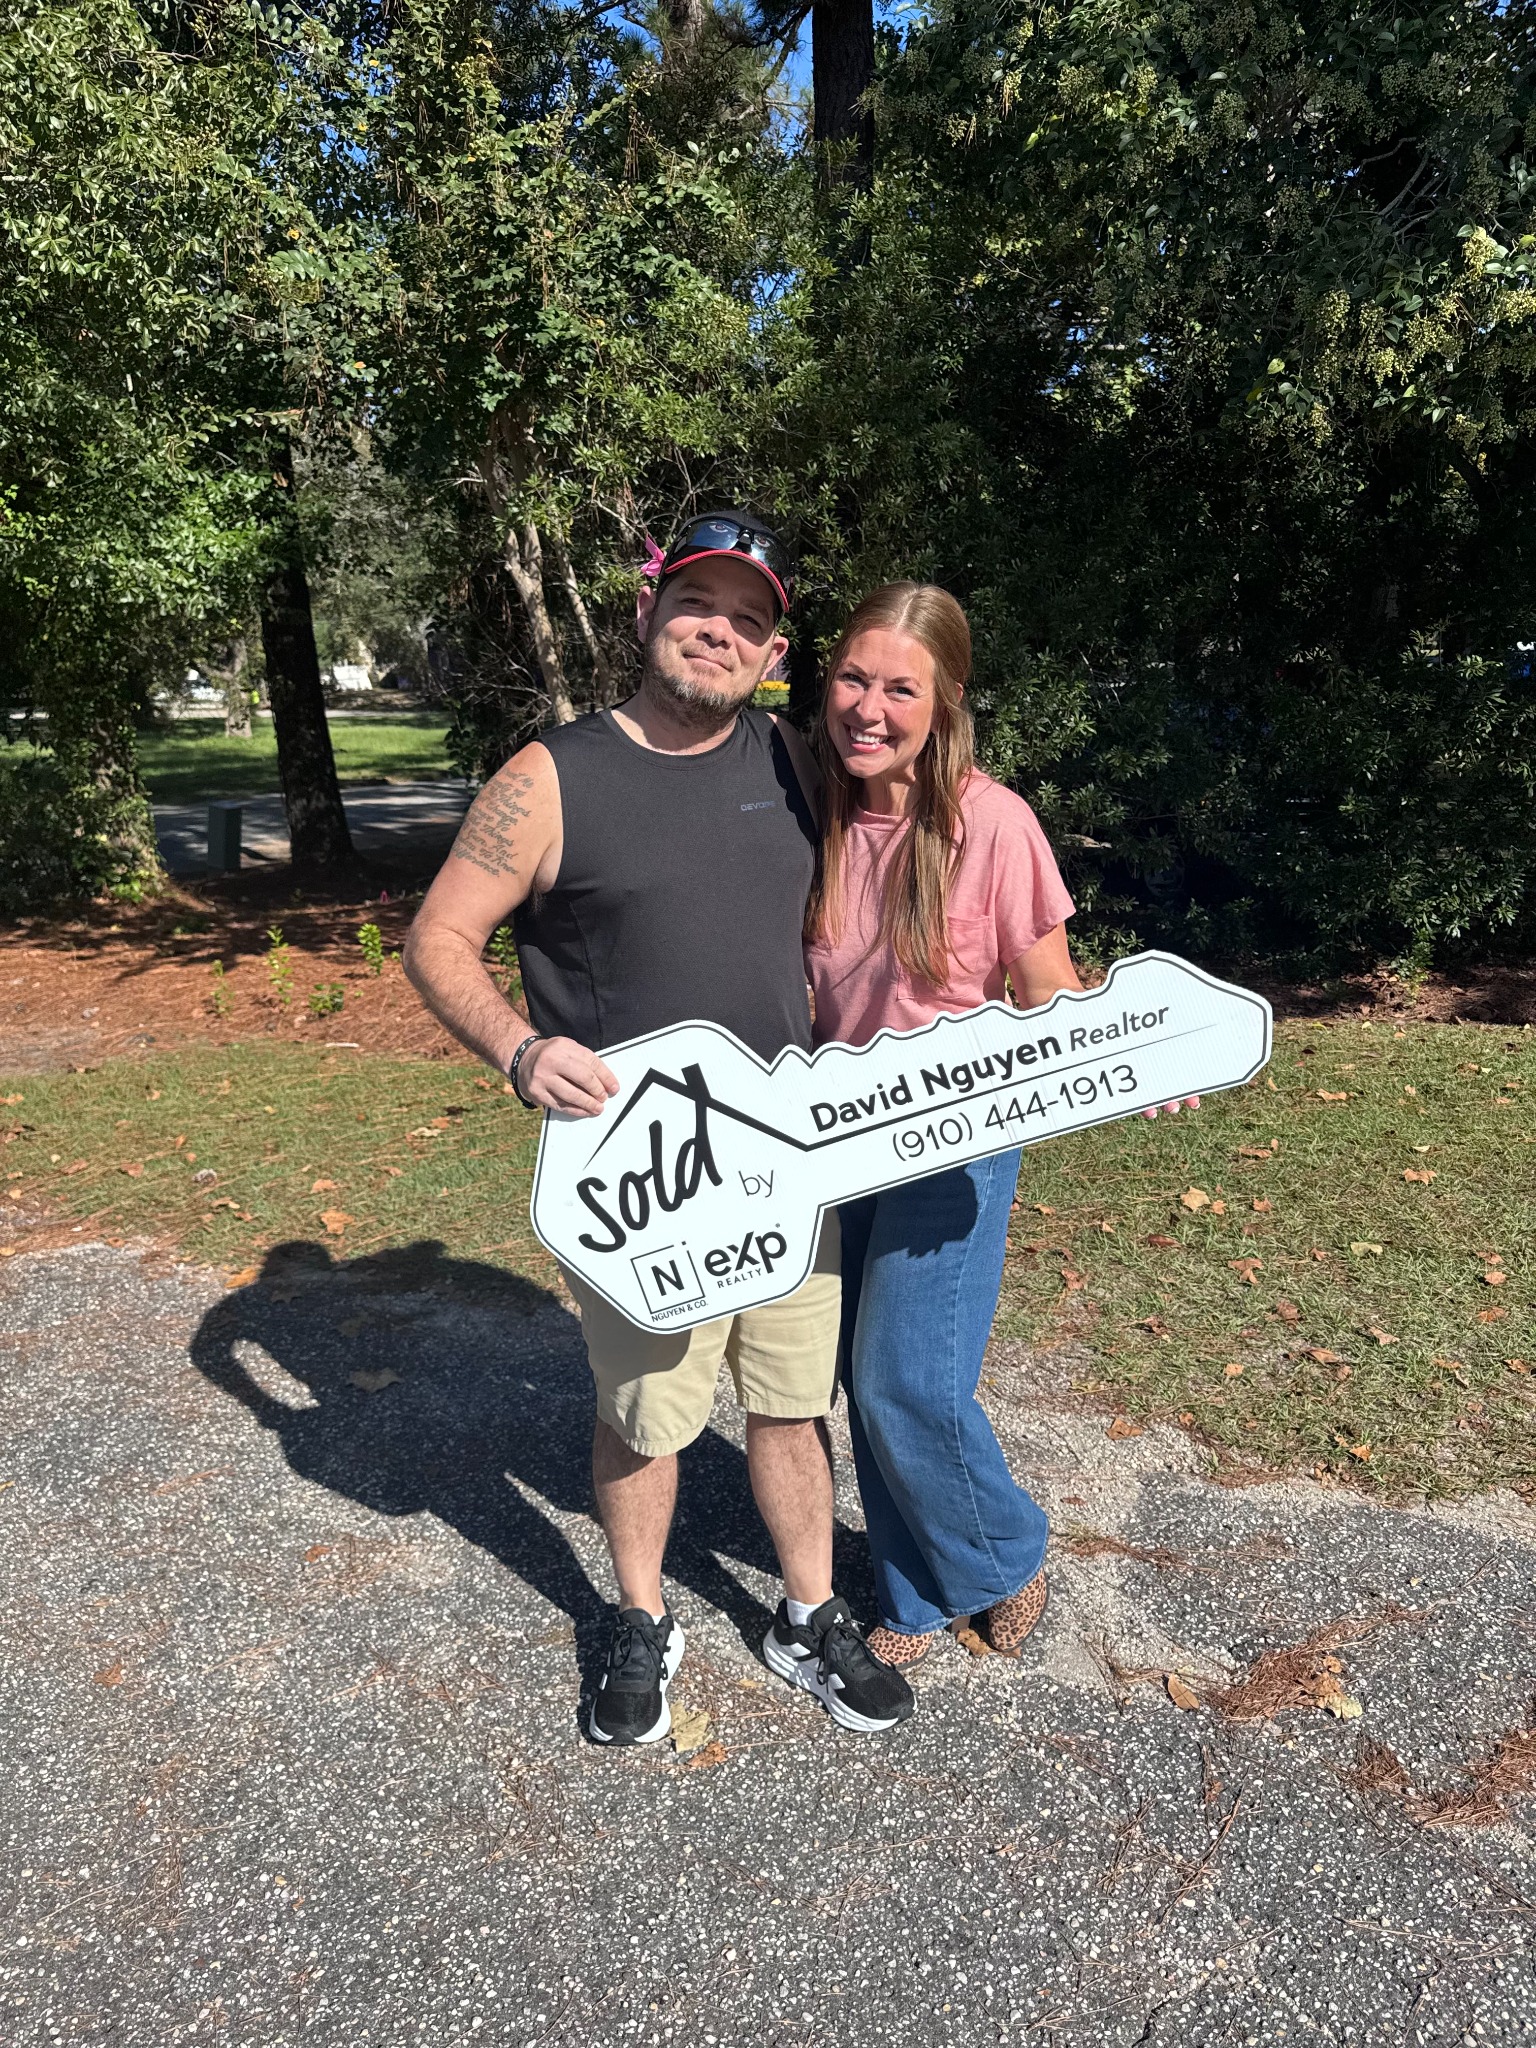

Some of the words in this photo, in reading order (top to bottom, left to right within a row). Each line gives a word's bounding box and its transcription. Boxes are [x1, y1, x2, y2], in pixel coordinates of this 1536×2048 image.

[480, 823, 515, 847] Things
[479, 848, 494, 860] To
[492, 856, 519, 876] Know
[488, 844, 519, 860] And
[809, 1074, 914, 1133] David
[919, 1035, 1063, 1097] Nguyen
[1069, 1006, 1170, 1052] Realtor
[892, 1112, 973, 1162] (910)
[984, 1064, 1138, 1130] 444-1913
[576, 1090, 723, 1253] Sold
[738, 1169, 774, 1198] by
[650, 1259, 685, 1297] N
[716, 1268, 763, 1289] REALTY
[651, 1307, 686, 1323] NGUYEN
[686, 1303, 693, 1311] &
[694, 1299, 709, 1309] CO.
